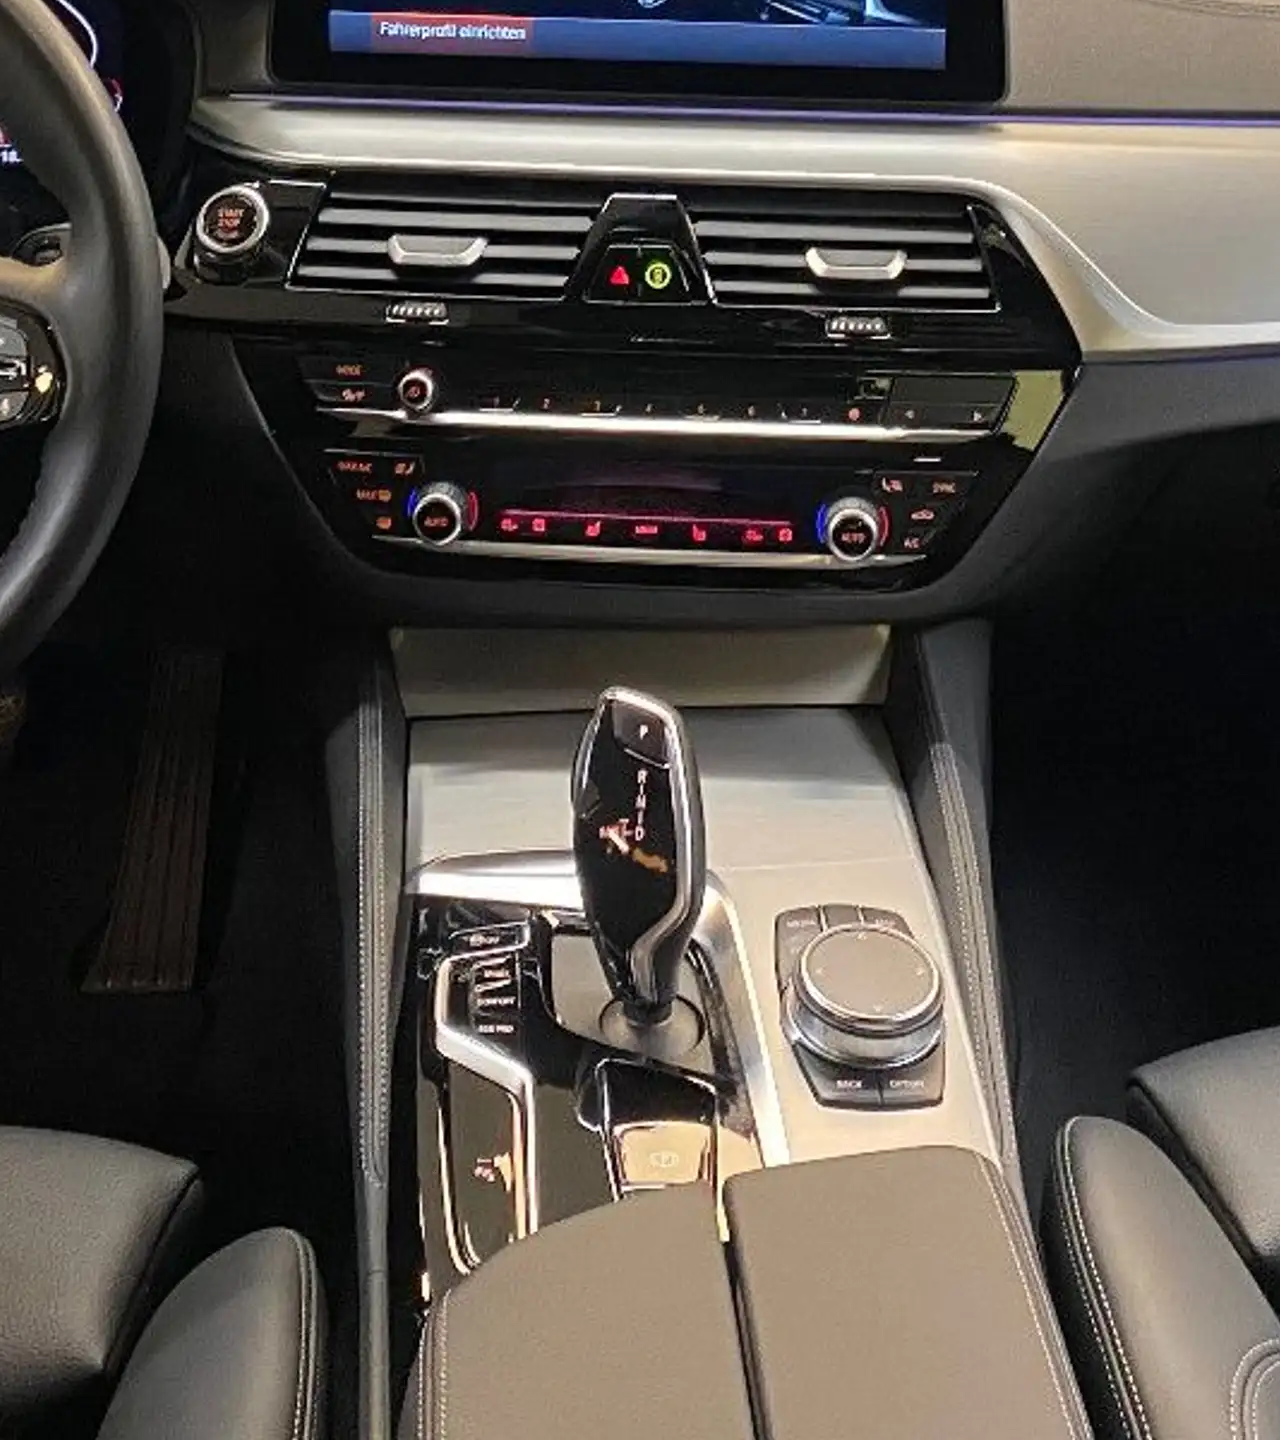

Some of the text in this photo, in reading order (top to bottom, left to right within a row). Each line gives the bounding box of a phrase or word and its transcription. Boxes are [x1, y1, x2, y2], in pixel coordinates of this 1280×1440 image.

[379, 21, 527, 41] Fahrerprofil einrichten
[639, 724, 649, 740] P
[634, 824, 646, 842] D
[836, 1079, 925, 1089] BACK OPTION
